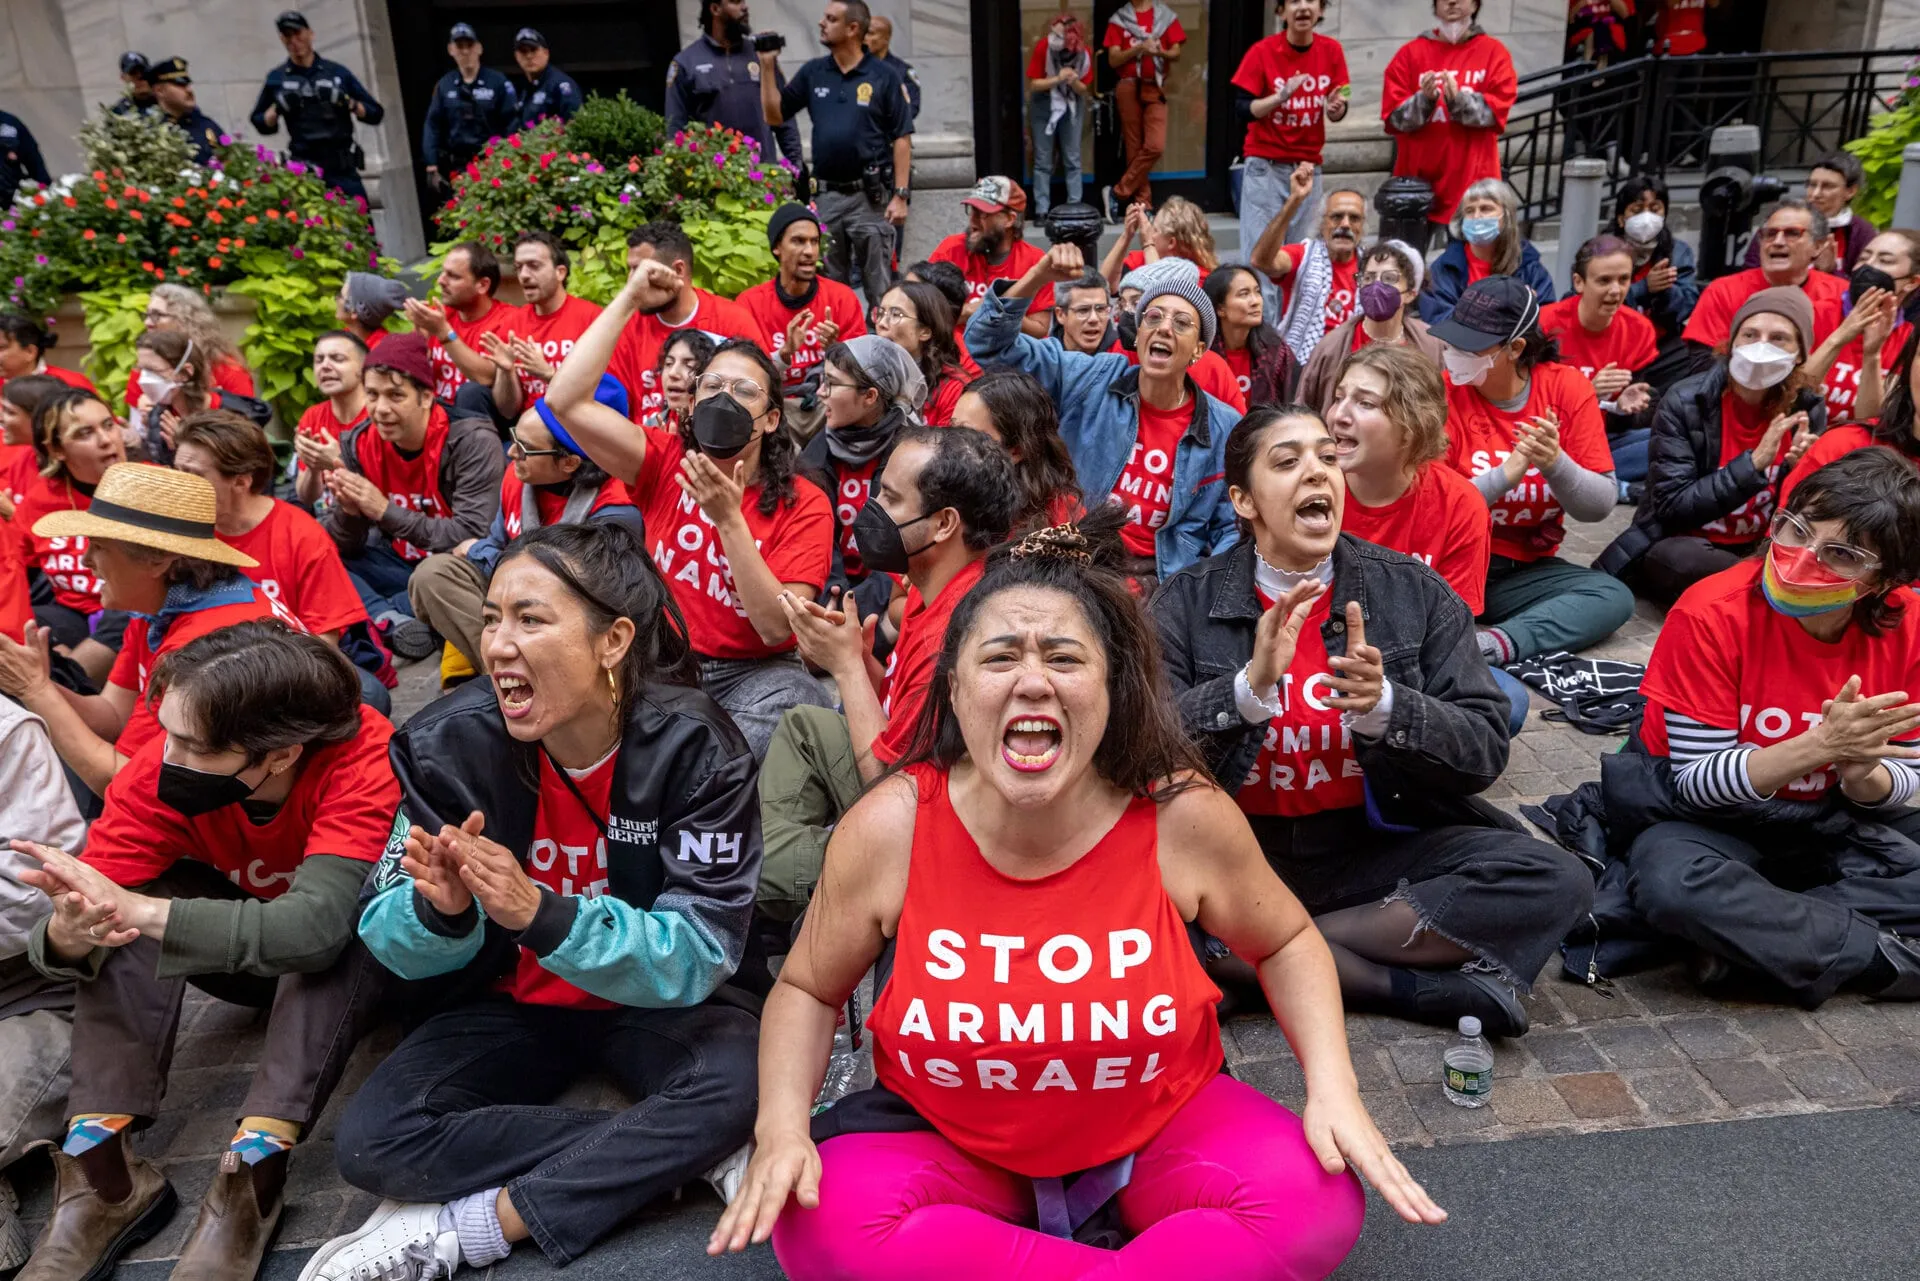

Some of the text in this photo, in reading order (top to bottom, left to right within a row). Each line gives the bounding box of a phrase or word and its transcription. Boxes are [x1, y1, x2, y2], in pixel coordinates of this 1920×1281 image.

[1274, 75, 1331, 92] SOP
[677, 830, 743, 864] NY
[925, 928, 1152, 984] STOP
[899, 994, 1177, 1043] ARMING
[898, 1049, 1167, 1091] ISRAEL
